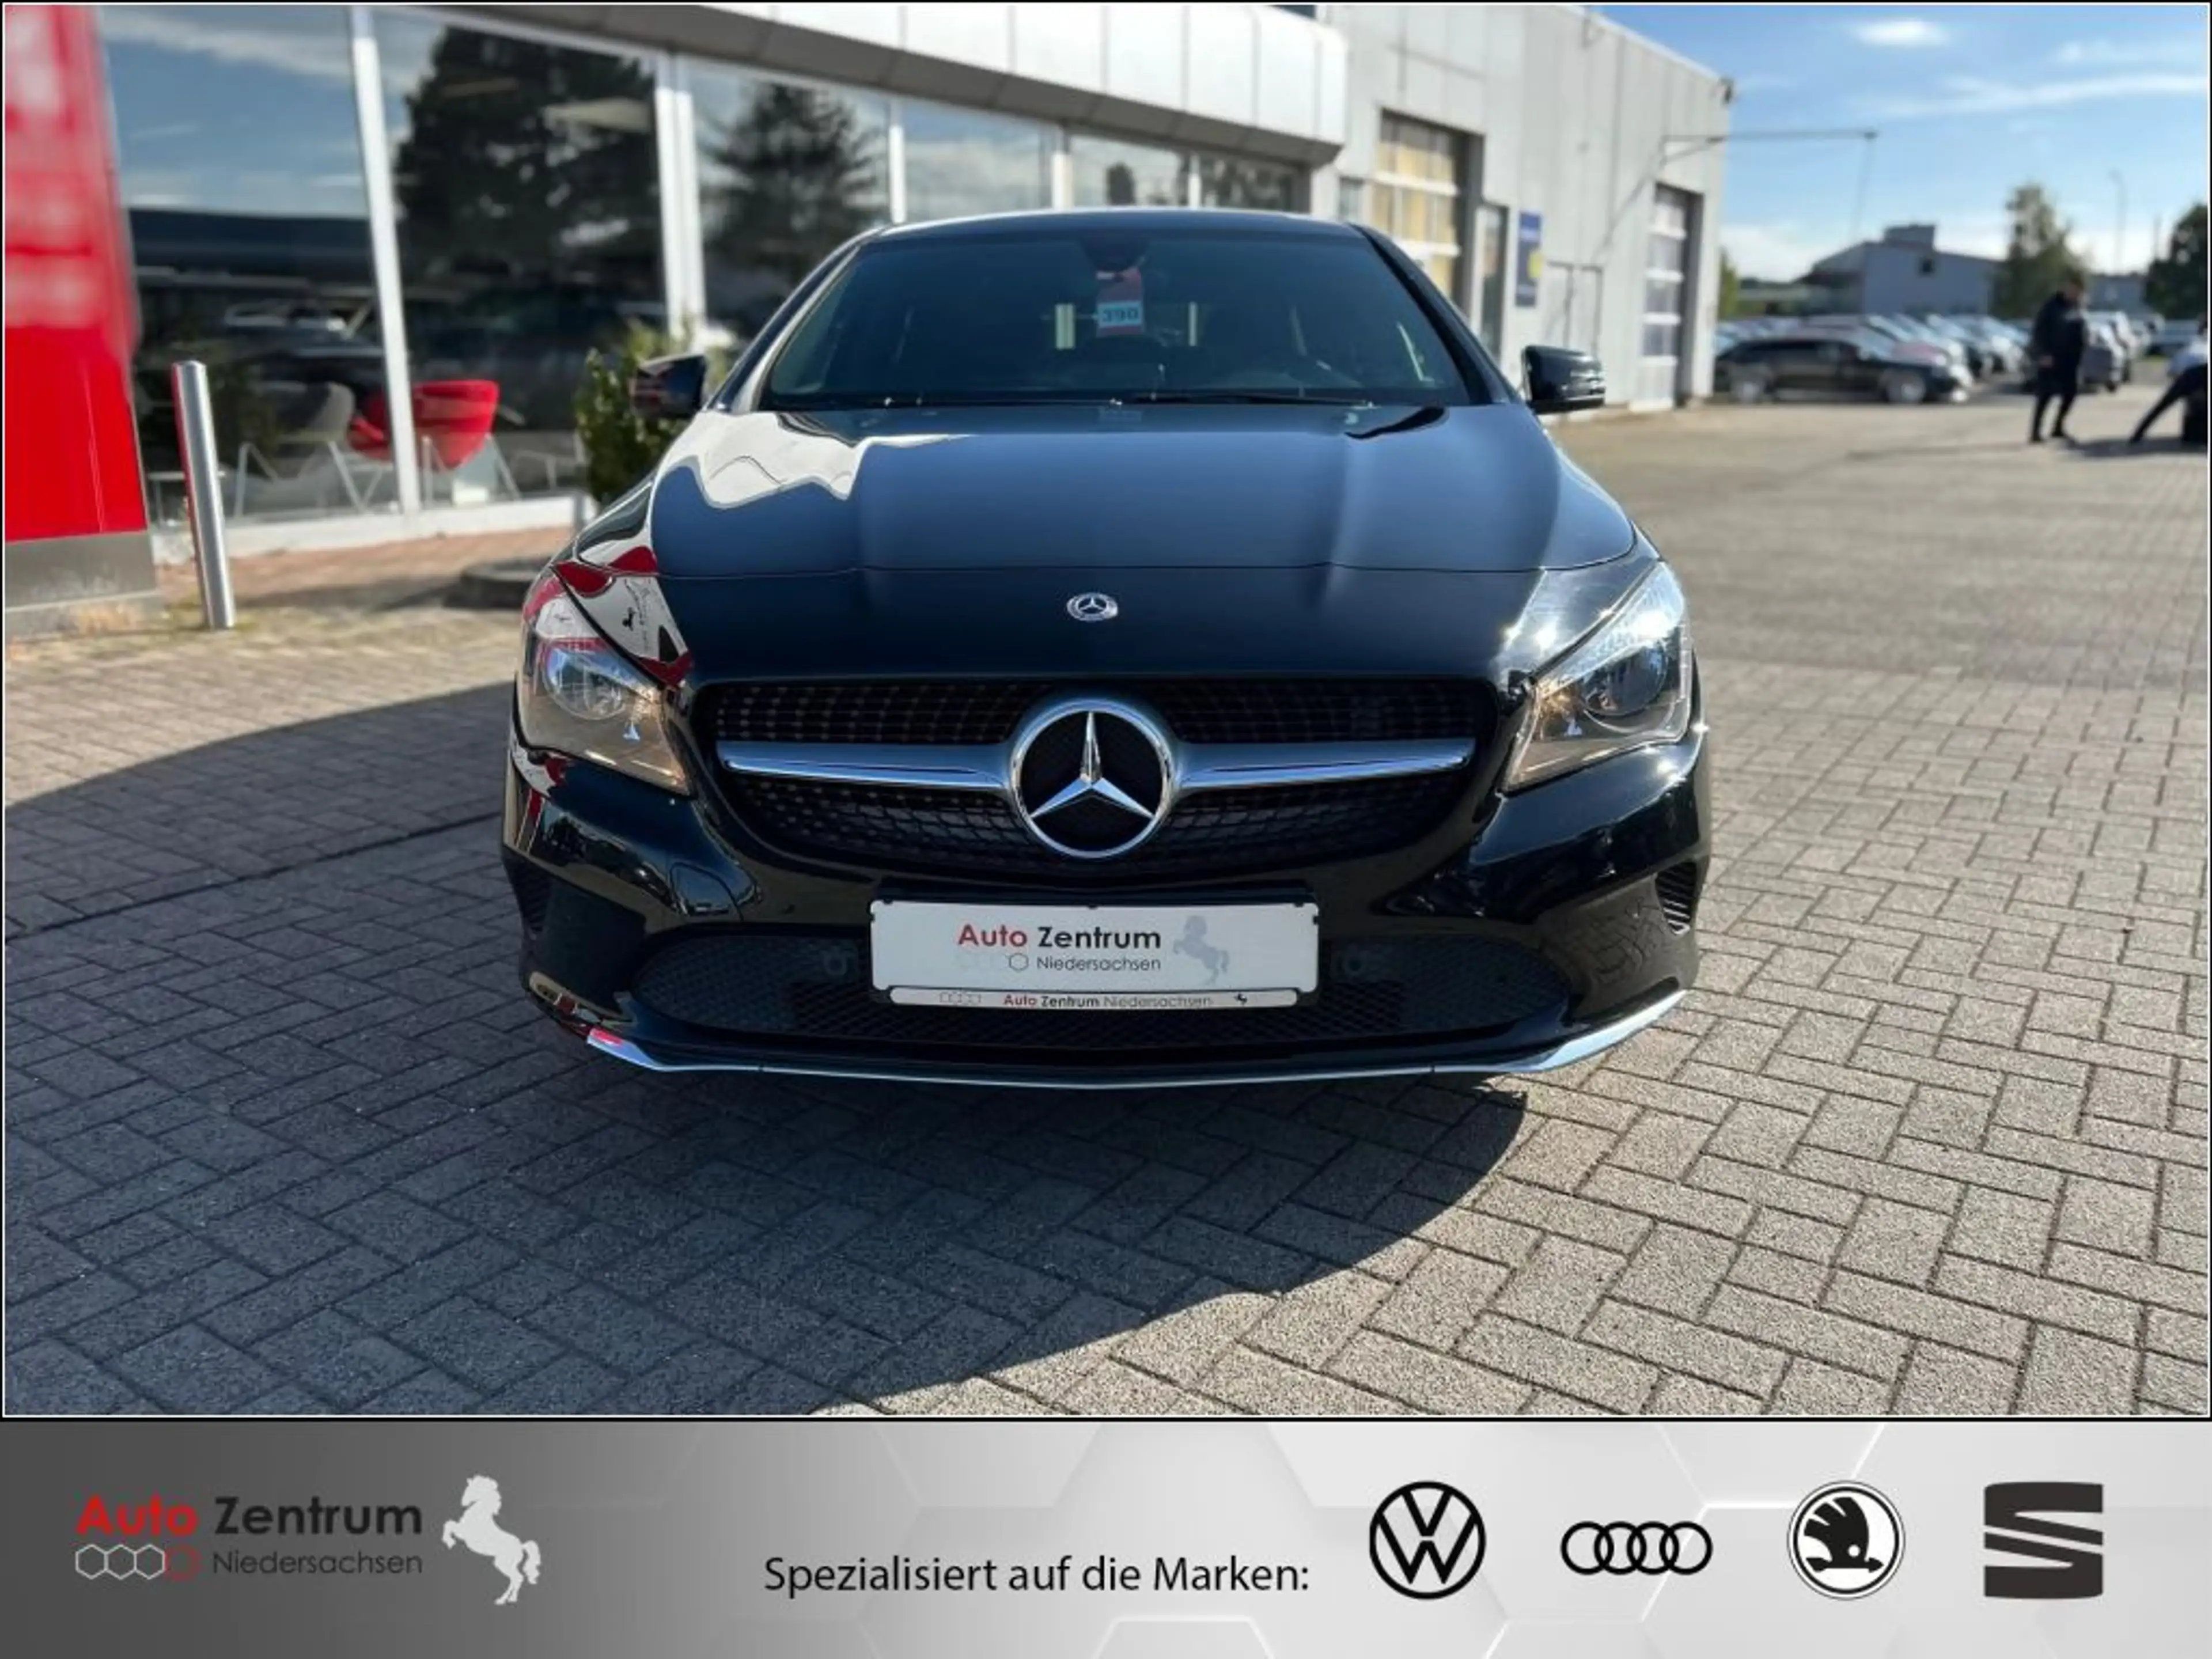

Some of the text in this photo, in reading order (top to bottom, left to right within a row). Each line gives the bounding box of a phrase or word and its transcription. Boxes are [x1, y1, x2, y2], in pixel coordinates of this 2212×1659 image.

[957, 924, 1161, 949] Auto Zentrum
[1036, 956, 1162, 972] Niedersachsen
[1003, 994, 1212, 1009] Auto Zentrum Niedersachsen
